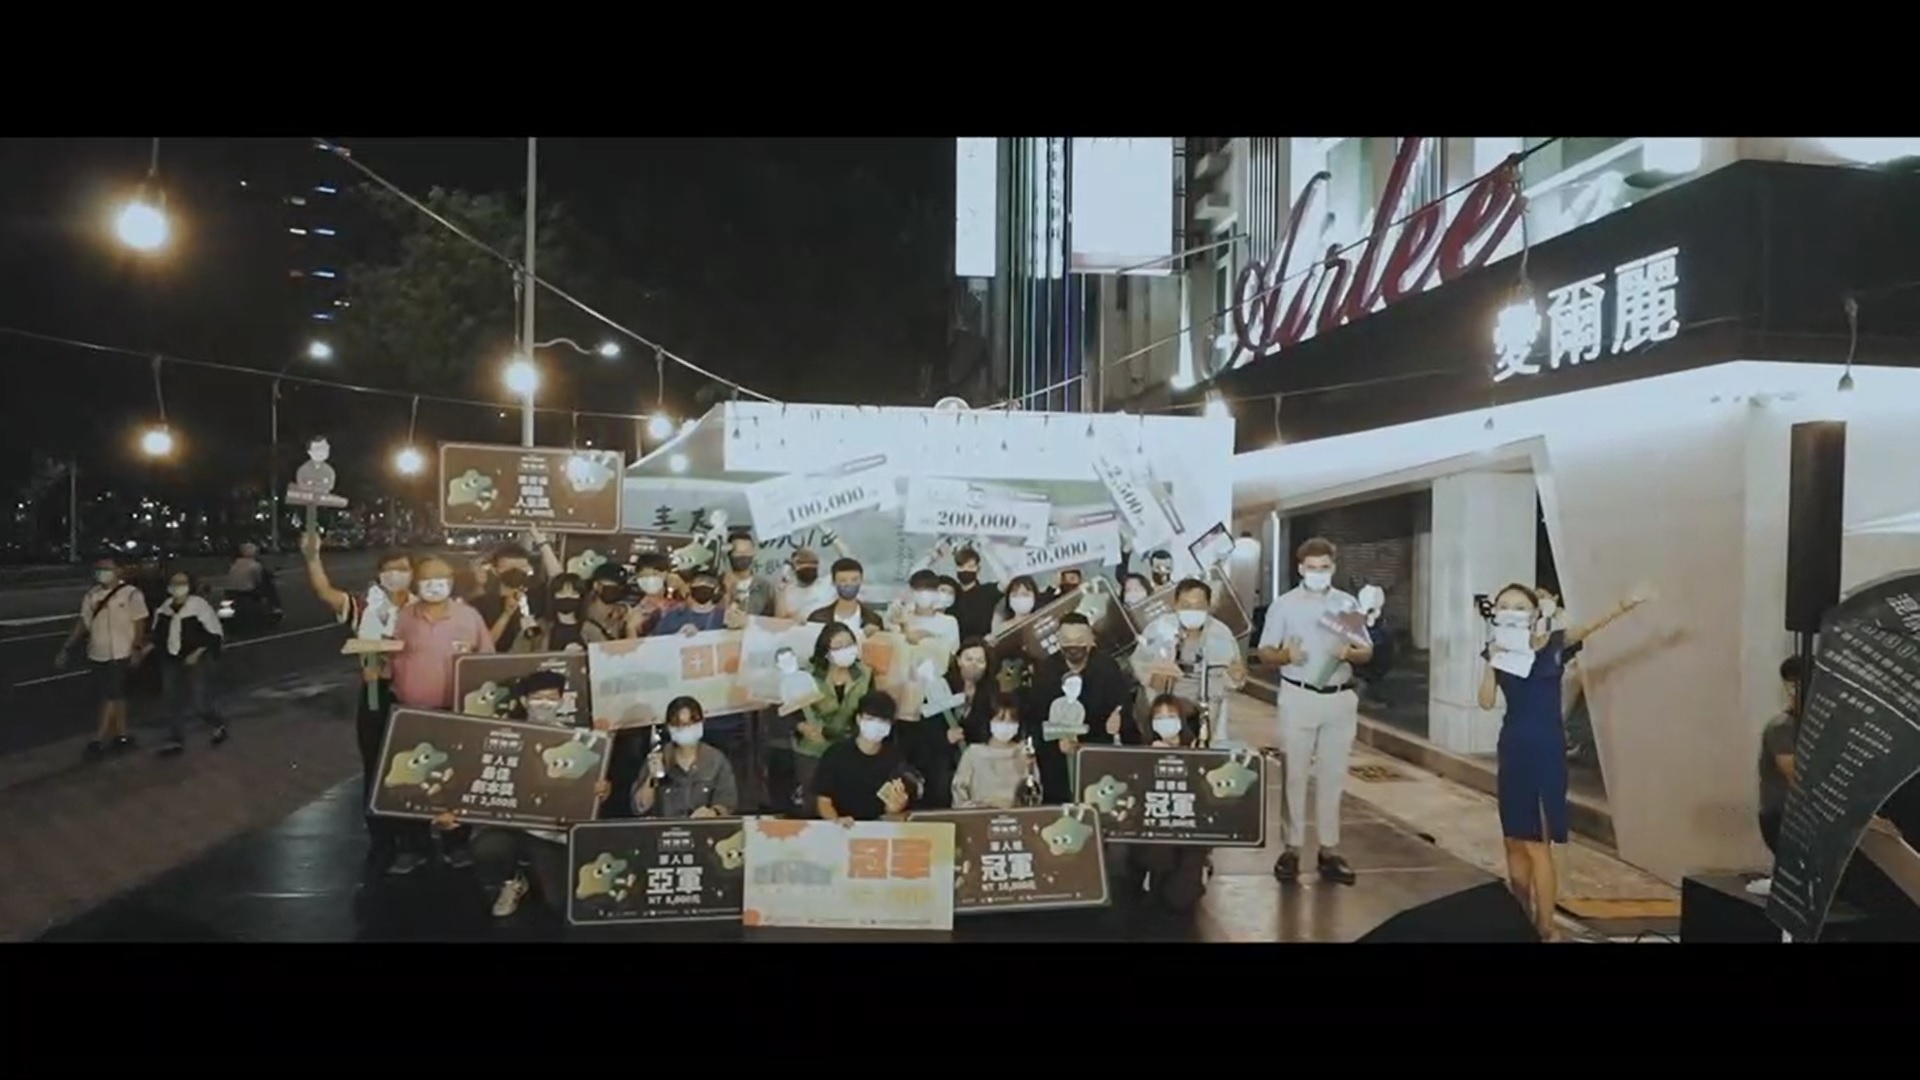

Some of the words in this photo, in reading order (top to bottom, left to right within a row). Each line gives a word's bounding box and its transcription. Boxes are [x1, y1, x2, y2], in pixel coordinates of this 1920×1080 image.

[1493, 247, 1680, 382] 愛爾麗
[788, 486, 865, 523] 100,000
[937, 510, 1017, 529] 200,000
[1026, 540, 1087, 568] 50,000
[1144, 792, 1196, 818] 冠軍
[646, 866, 703, 894] 亞軍
[981, 852, 1034, 881] 冠軍
